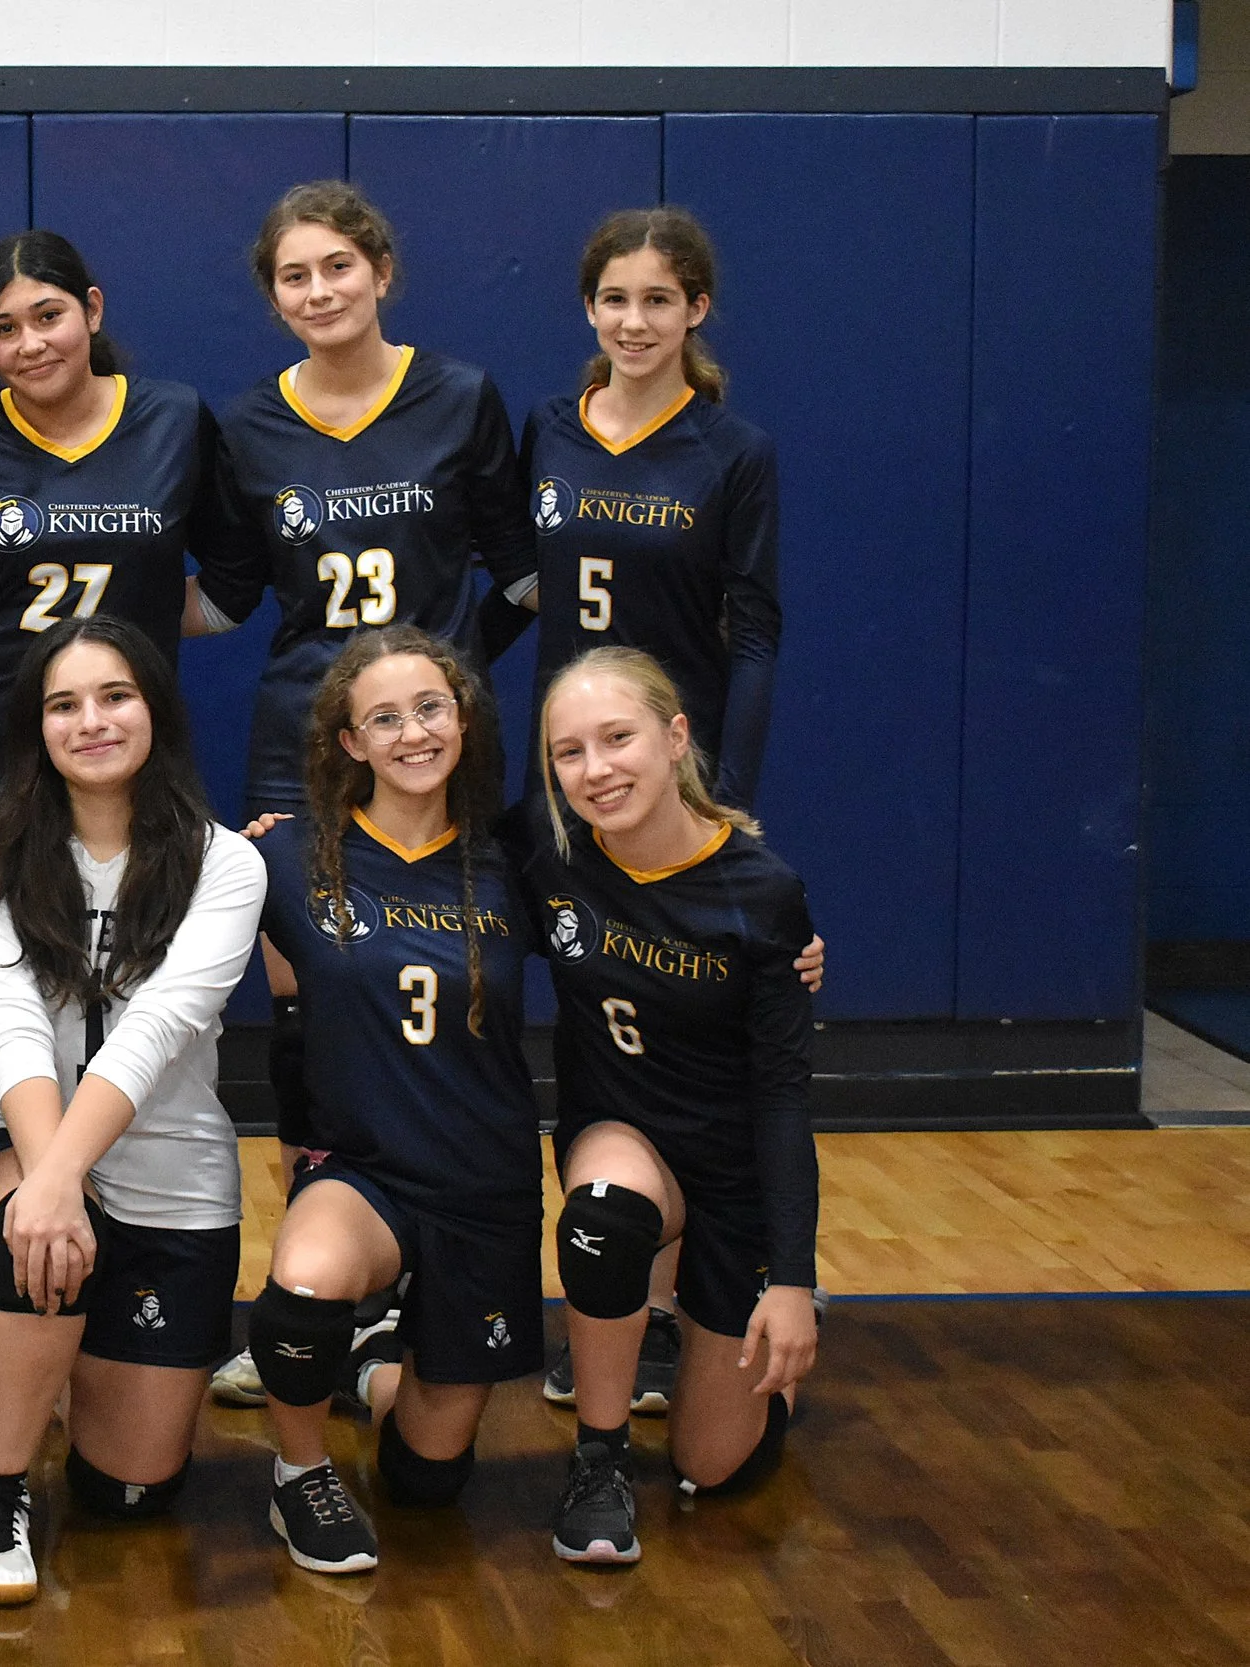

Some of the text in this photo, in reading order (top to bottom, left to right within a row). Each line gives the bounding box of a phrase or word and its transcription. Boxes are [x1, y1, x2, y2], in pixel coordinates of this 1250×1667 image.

[48, 503, 140, 511] CHESTERTON ACADEMY
[325, 481, 410, 496] CHESTERTON ACADEMY
[325, 483, 434, 522] KNIGHTS
[576, 497, 695, 530] KNIGHTS
[47, 506, 162, 536] KNIGHTS
[19, 562, 113, 633] 27
[317, 547, 397, 628] 23
[578, 556, 614, 632] 5
[601, 929, 728, 981] KNIGHTS
[398, 964, 439, 1045] 3
[601, 997, 645, 1055] 6
